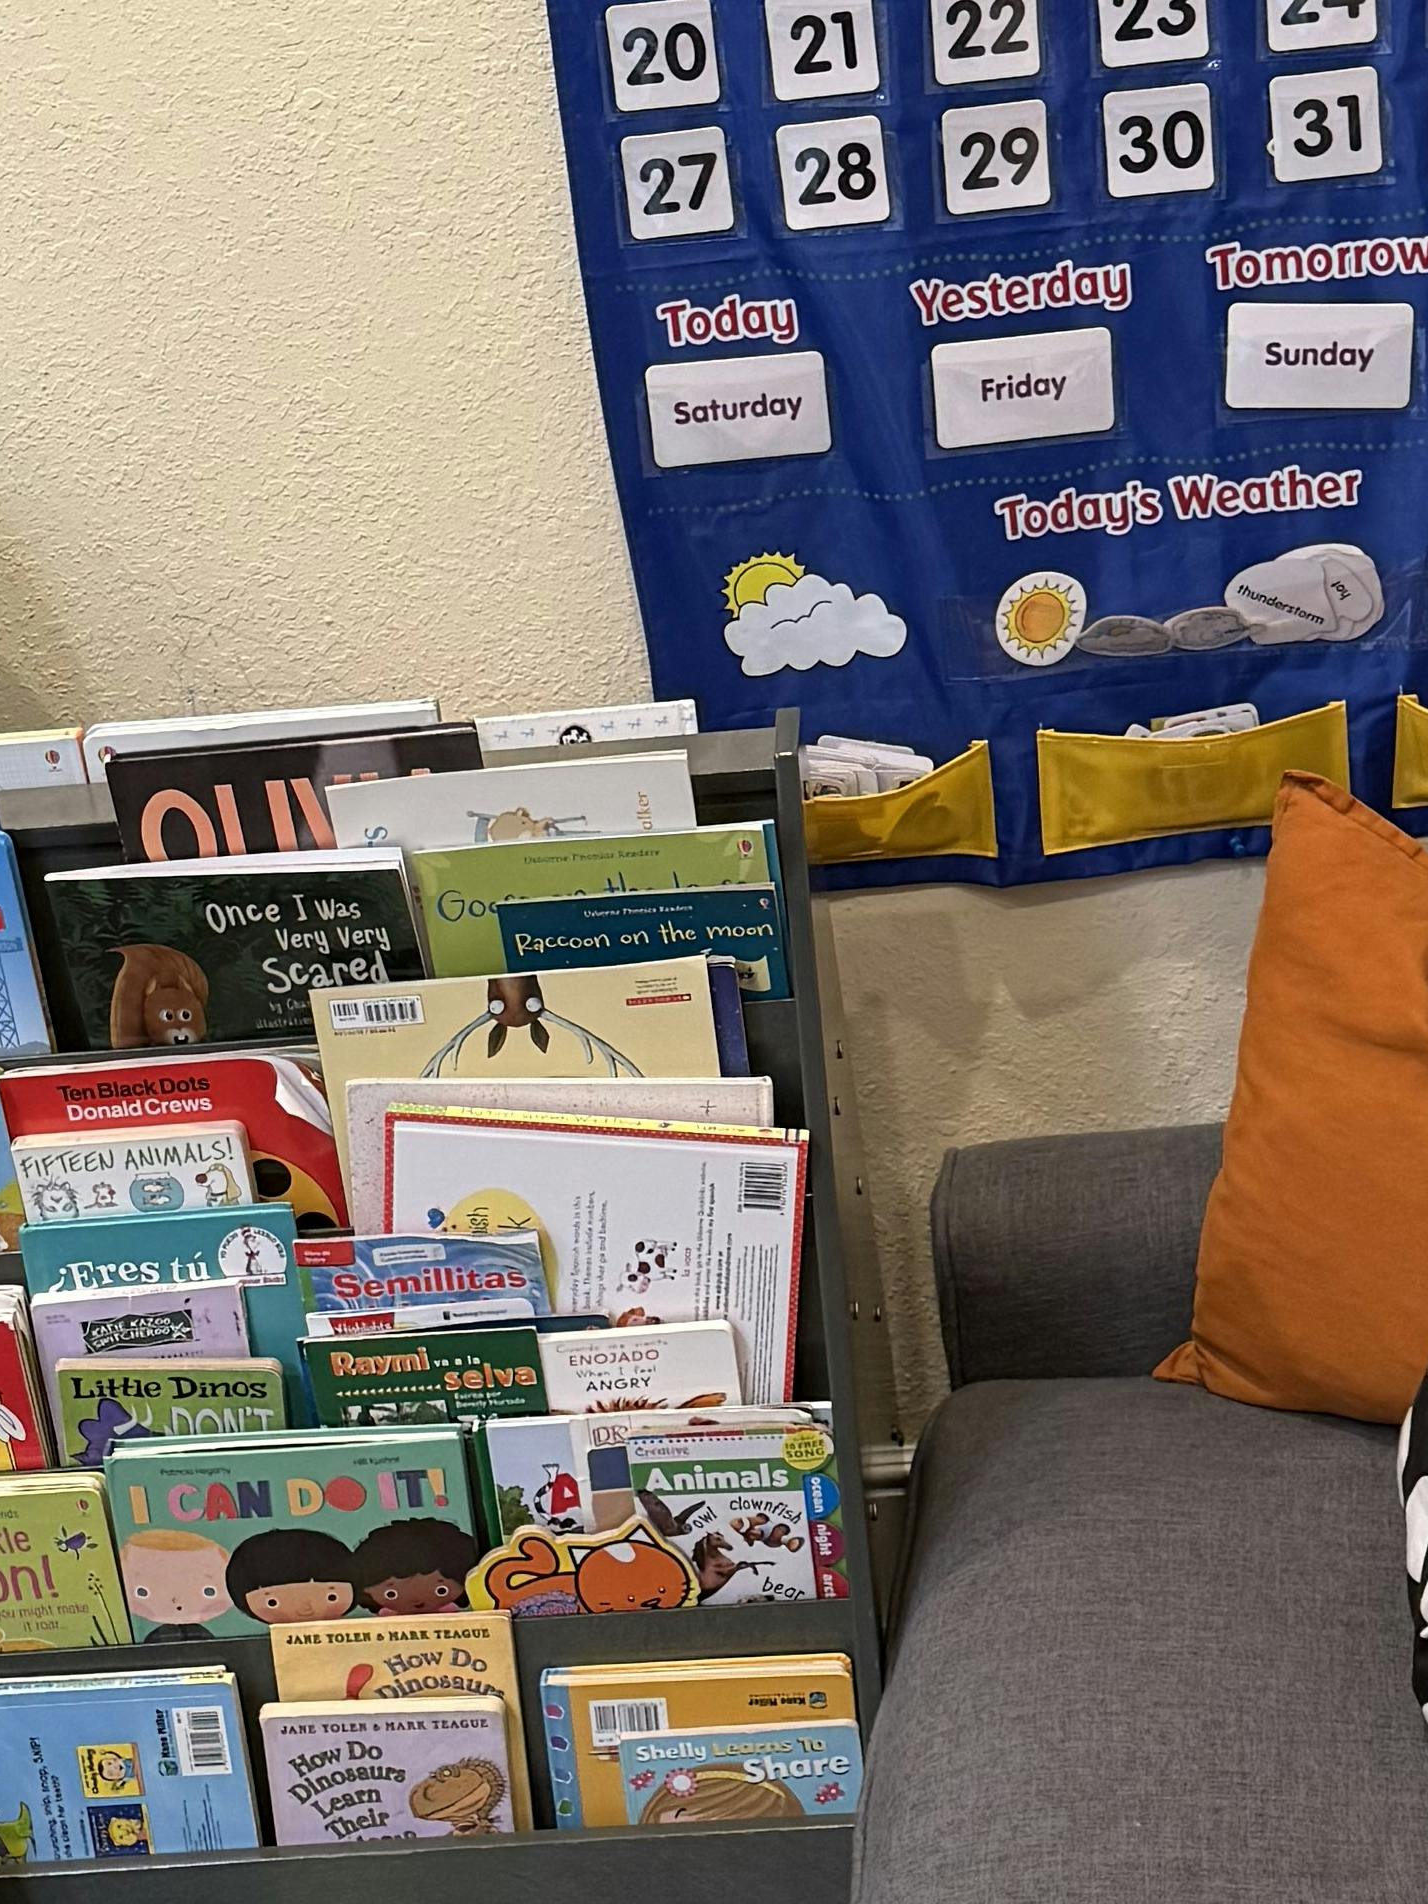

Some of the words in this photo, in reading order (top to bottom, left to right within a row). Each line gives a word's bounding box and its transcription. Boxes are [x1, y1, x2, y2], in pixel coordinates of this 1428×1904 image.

[623, 23, 706, 85] 20
[791, 11, 857, 74] 21
[640, 153, 717, 215] 27
[795, 143, 876, 205] 28
[961, 127, 1039, 190] 29
[1119, 111, 1204, 173] 30
[1294, 95, 1361, 157] 31
[912, 261, 1130, 325] Yesterday
[659, 297, 797, 346] Today
[1265, 343, 1374, 371] Sunday
[981, 374, 1067, 403] Friday
[674, 393, 803, 424] Saturday
[996, 481, 1161, 540] Today's
[1169, 467, 1362, 519] Weather
[1237, 584, 1325, 627] thunderstorm
[206, 903, 280, 933] Once
[292, 894, 307, 921] I
[315, 899, 362, 920] Was
[275, 928, 329, 954] Very
[336, 927, 391, 950] Very
[515, 931, 610, 955] Raccoon
[621, 931, 649, 945] on
[658, 921, 696, 943] the
[707, 921, 773, 940] moon
[262, 951, 389, 993] Scared
[58, 1085, 96, 1102] Ten
[98, 1079, 158, 1099] Black
[159, 1076, 210, 1094] Dots
[66, 1100, 144, 1121] Donald
[145, 1096, 212, 1114] Crews
[20, 1149, 114, 1179] FIFTEEN
[125, 1137, 234, 1171] ANIMALS!
[333, 1267, 527, 1300] Semillitas
[71, 1377, 161, 1399] Little
[168, 1377, 267, 1398] Dinos
[645, 1464, 789, 1492] Animals
[129, 1485, 151, 1524] I
[167, 1480, 273, 1522] CAN
[286, 1475, 366, 1516] DO
[376, 1468, 448, 1511] IT!
[729, 1497, 803, 1525] clownfish
[636, 1742, 706, 1763] Shelly
[712, 1739, 792, 1757] Learns
[798, 1737, 826, 1752] To
[743, 1754, 850, 1784] Share
